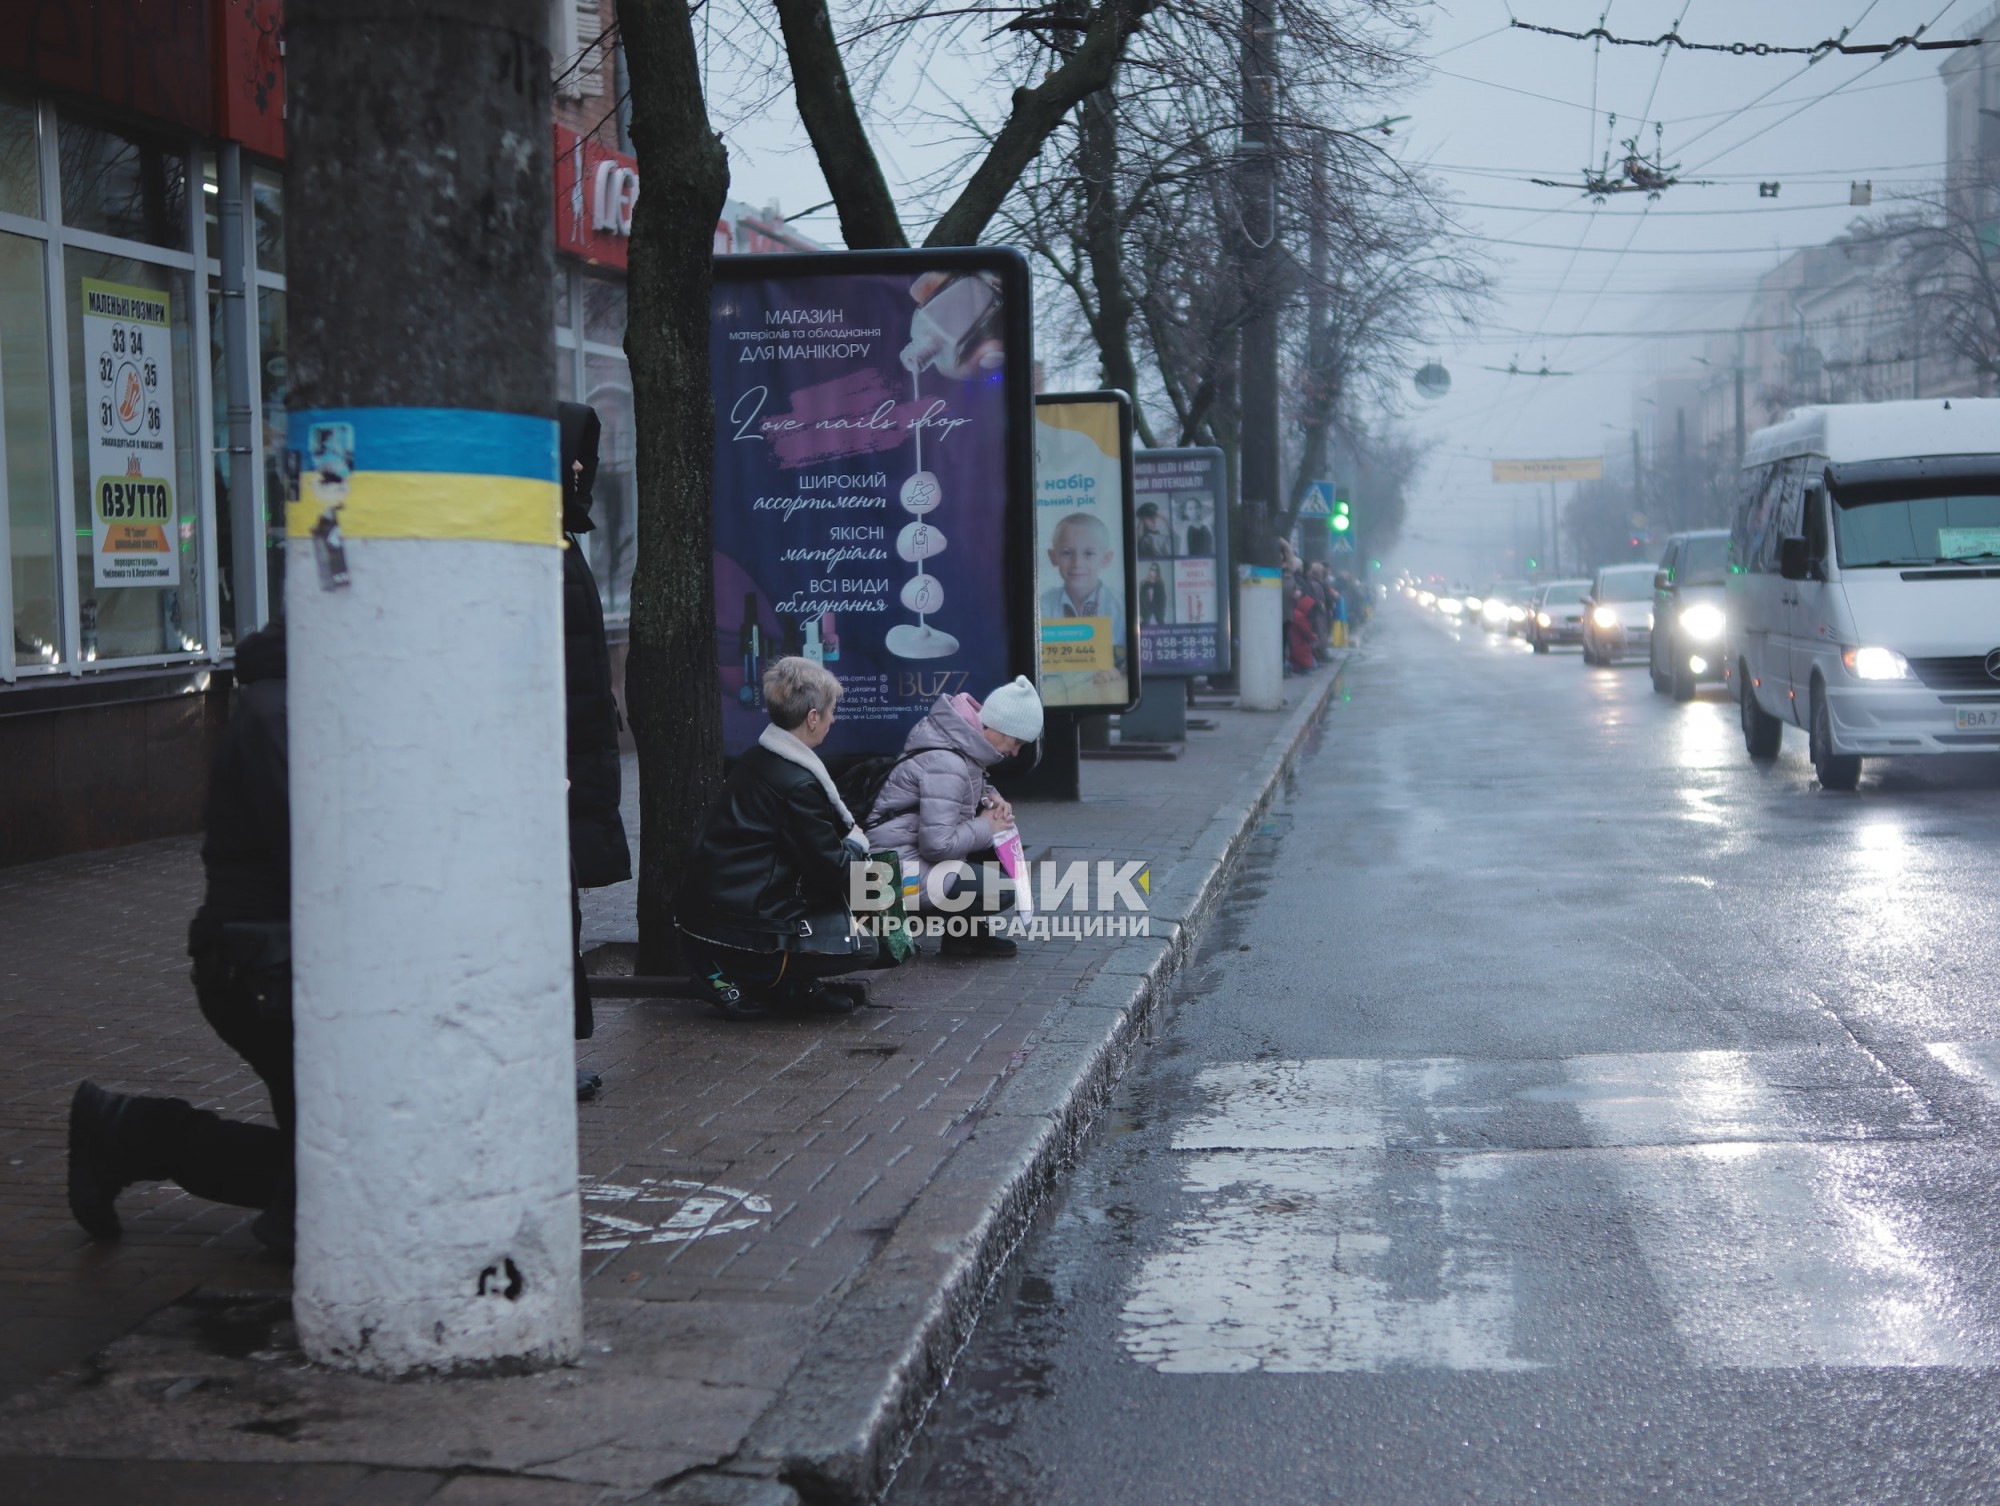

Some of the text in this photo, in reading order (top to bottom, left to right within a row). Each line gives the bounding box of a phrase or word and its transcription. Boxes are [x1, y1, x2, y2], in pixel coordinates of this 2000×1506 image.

[89, 291, 165, 323] МАЛЕНЬКІ РОЗМІРИ
[765, 308, 844, 325] МАГАЗИН
[112, 328, 143, 355] 33 34
[729, 327, 881, 341] матеріалів та обладнання
[739, 343, 871, 363] ДЛЯ МАНІКЮРУ
[100, 357, 113, 381] 32
[144, 363, 157, 387] 35
[102, 402, 113, 426] 31
[148, 406, 160, 430] 36
[730, 385, 973, 442] Love nails shop
[799, 471, 886, 489] ШИРОКИЙ
[1044, 473, 1096, 492] набір
[102, 482, 167, 518] ВЗУТТЯ
[753, 494, 887, 523] ассортимент
[1036, 494, 1097, 508] льний рік
[830, 526, 884, 541] ЯКІСНІ
[780, 544, 888, 574] матеріали
[810, 578, 889, 594] ВСІ ВИДИ
[775, 590, 889, 631] обладнання
[1061, 646, 1073, 656] 29
[1075, 644, 1096, 655] 444
[1141, 635, 1216, 650] 0) 458-58-84
[1141, 647, 1216, 663] 0) 528-56-20
[842, 685, 877, 693] al_ukraine
[899, 671, 970, 697] BUZZ
